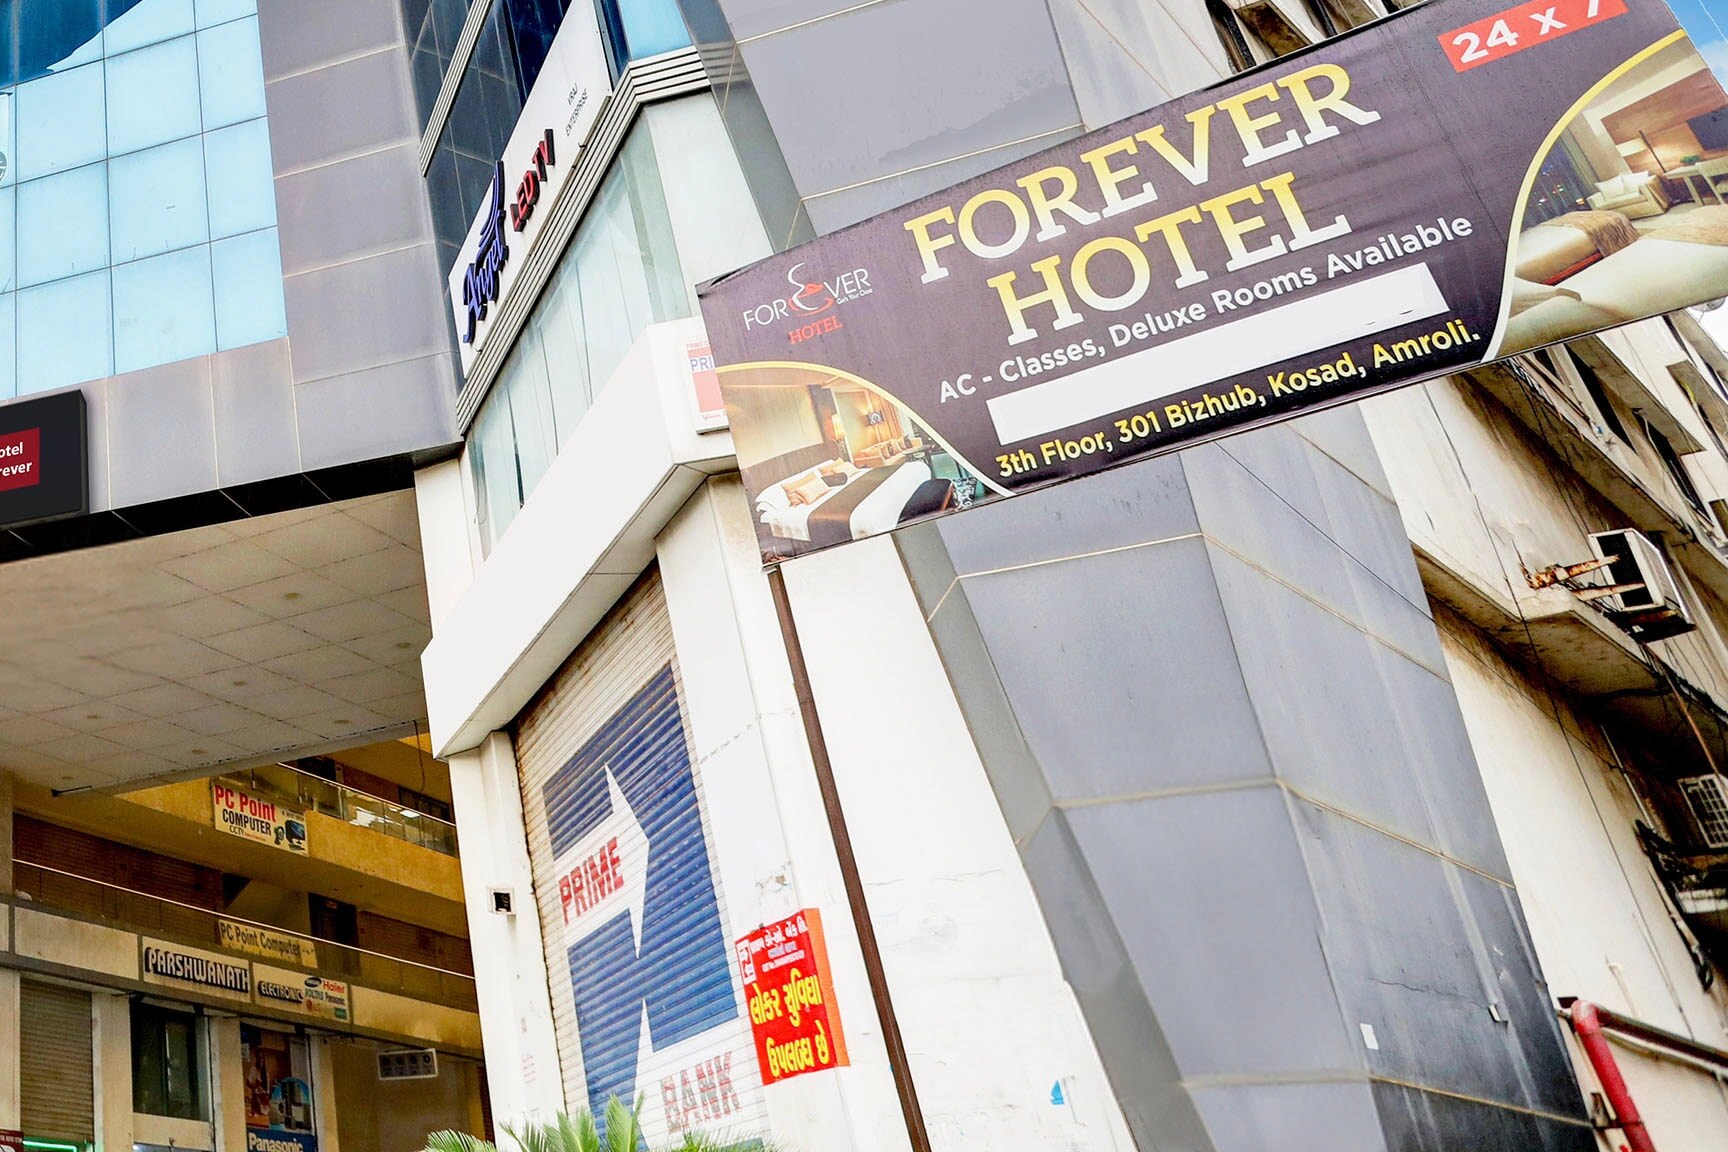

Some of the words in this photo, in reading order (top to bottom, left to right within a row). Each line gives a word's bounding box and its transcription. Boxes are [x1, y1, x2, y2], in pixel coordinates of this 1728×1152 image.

[1451, 24, 1519, 65] 24
[1536, 7, 1568, 36] x
[509, 170, 540, 232] LED
[533, 129, 556, 182] TV
[903, 62, 1382, 285] FOREVER
[988, 171, 1352, 346] HOTEL
[788, 315, 844, 344] HOTEL
[939, 372, 977, 403] AC
[998, 335, 1107, 384] Classes,
[1109, 301, 1207, 348] Deluxe
[1211, 264, 1318, 314] Rooms
[1326, 214, 1474, 280] Available
[995, 450, 1037, 479] 3th
[1040, 428, 1115, 469] Floor,
[1114, 411, 1159, 444] 301
[1167, 381, 1267, 429] Bizhub,
[1268, 352, 1367, 398] Kosad,
[1371, 319, 1481, 369] Amroli.
[215, 784, 235, 809] PC
[239, 792, 276, 823] Point
[222, 809, 272, 836] COMPUTER
[229, 825, 245, 835] CCTV
[558, 836, 624, 926] PRIME
[221, 923, 233, 939] PC
[236, 926, 258, 946] Point
[260, 931, 301, 956] Computer
[147, 947, 251, 993] PARSHWANATH
[323, 979, 345, 994] Haier
[750, 983, 783, 1025] લોકર
[782, 968, 822, 1027] સુવિધા
[766, 1037, 815, 1077] ઉપલબ્ધ
[815, 1020, 829, 1064] છે
[661, 1051, 742, 1134] BANK
[247, 1133, 302, 1152] Panasonic
